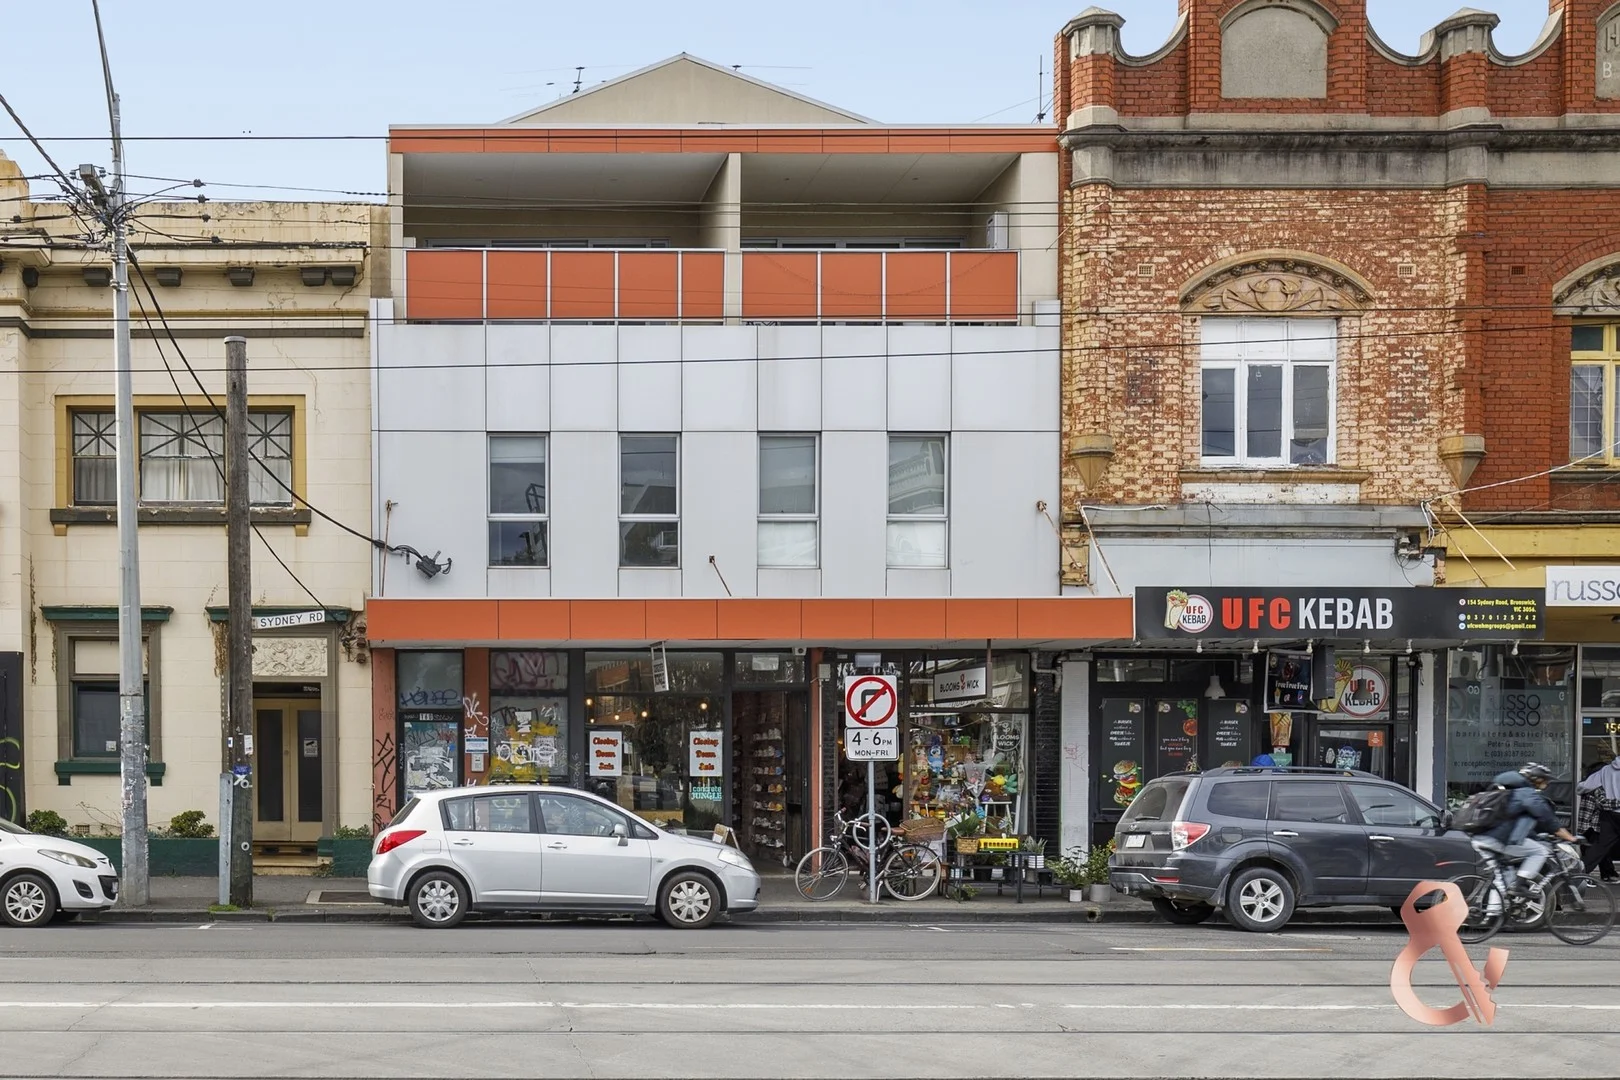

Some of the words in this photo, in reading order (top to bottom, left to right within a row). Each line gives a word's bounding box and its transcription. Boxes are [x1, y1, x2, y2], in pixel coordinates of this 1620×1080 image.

[1552, 580, 1620, 601] russ
[1186, 605, 1204, 614] UFC
[1222, 597, 1291, 630] UFC
[1298, 598, 1394, 630] KEBAB
[260, 614, 302, 628] SYDNEY
[310, 612, 323, 622] RD
[1182, 614, 1206, 624] KEBAB
[940, 682, 960, 692] BLOOMS
[966, 680, 980, 689] WICK
[1350, 679, 1375, 692] UC
[592, 736, 618, 746] Closing
[692, 736, 719, 746] Closing
[595, 750, 616, 758] Down
[695, 750, 716, 758] Down
[598, 762, 615, 771] Sale
[698, 762, 715, 771] Sale
[691, 792, 722, 800] JUNGLE
